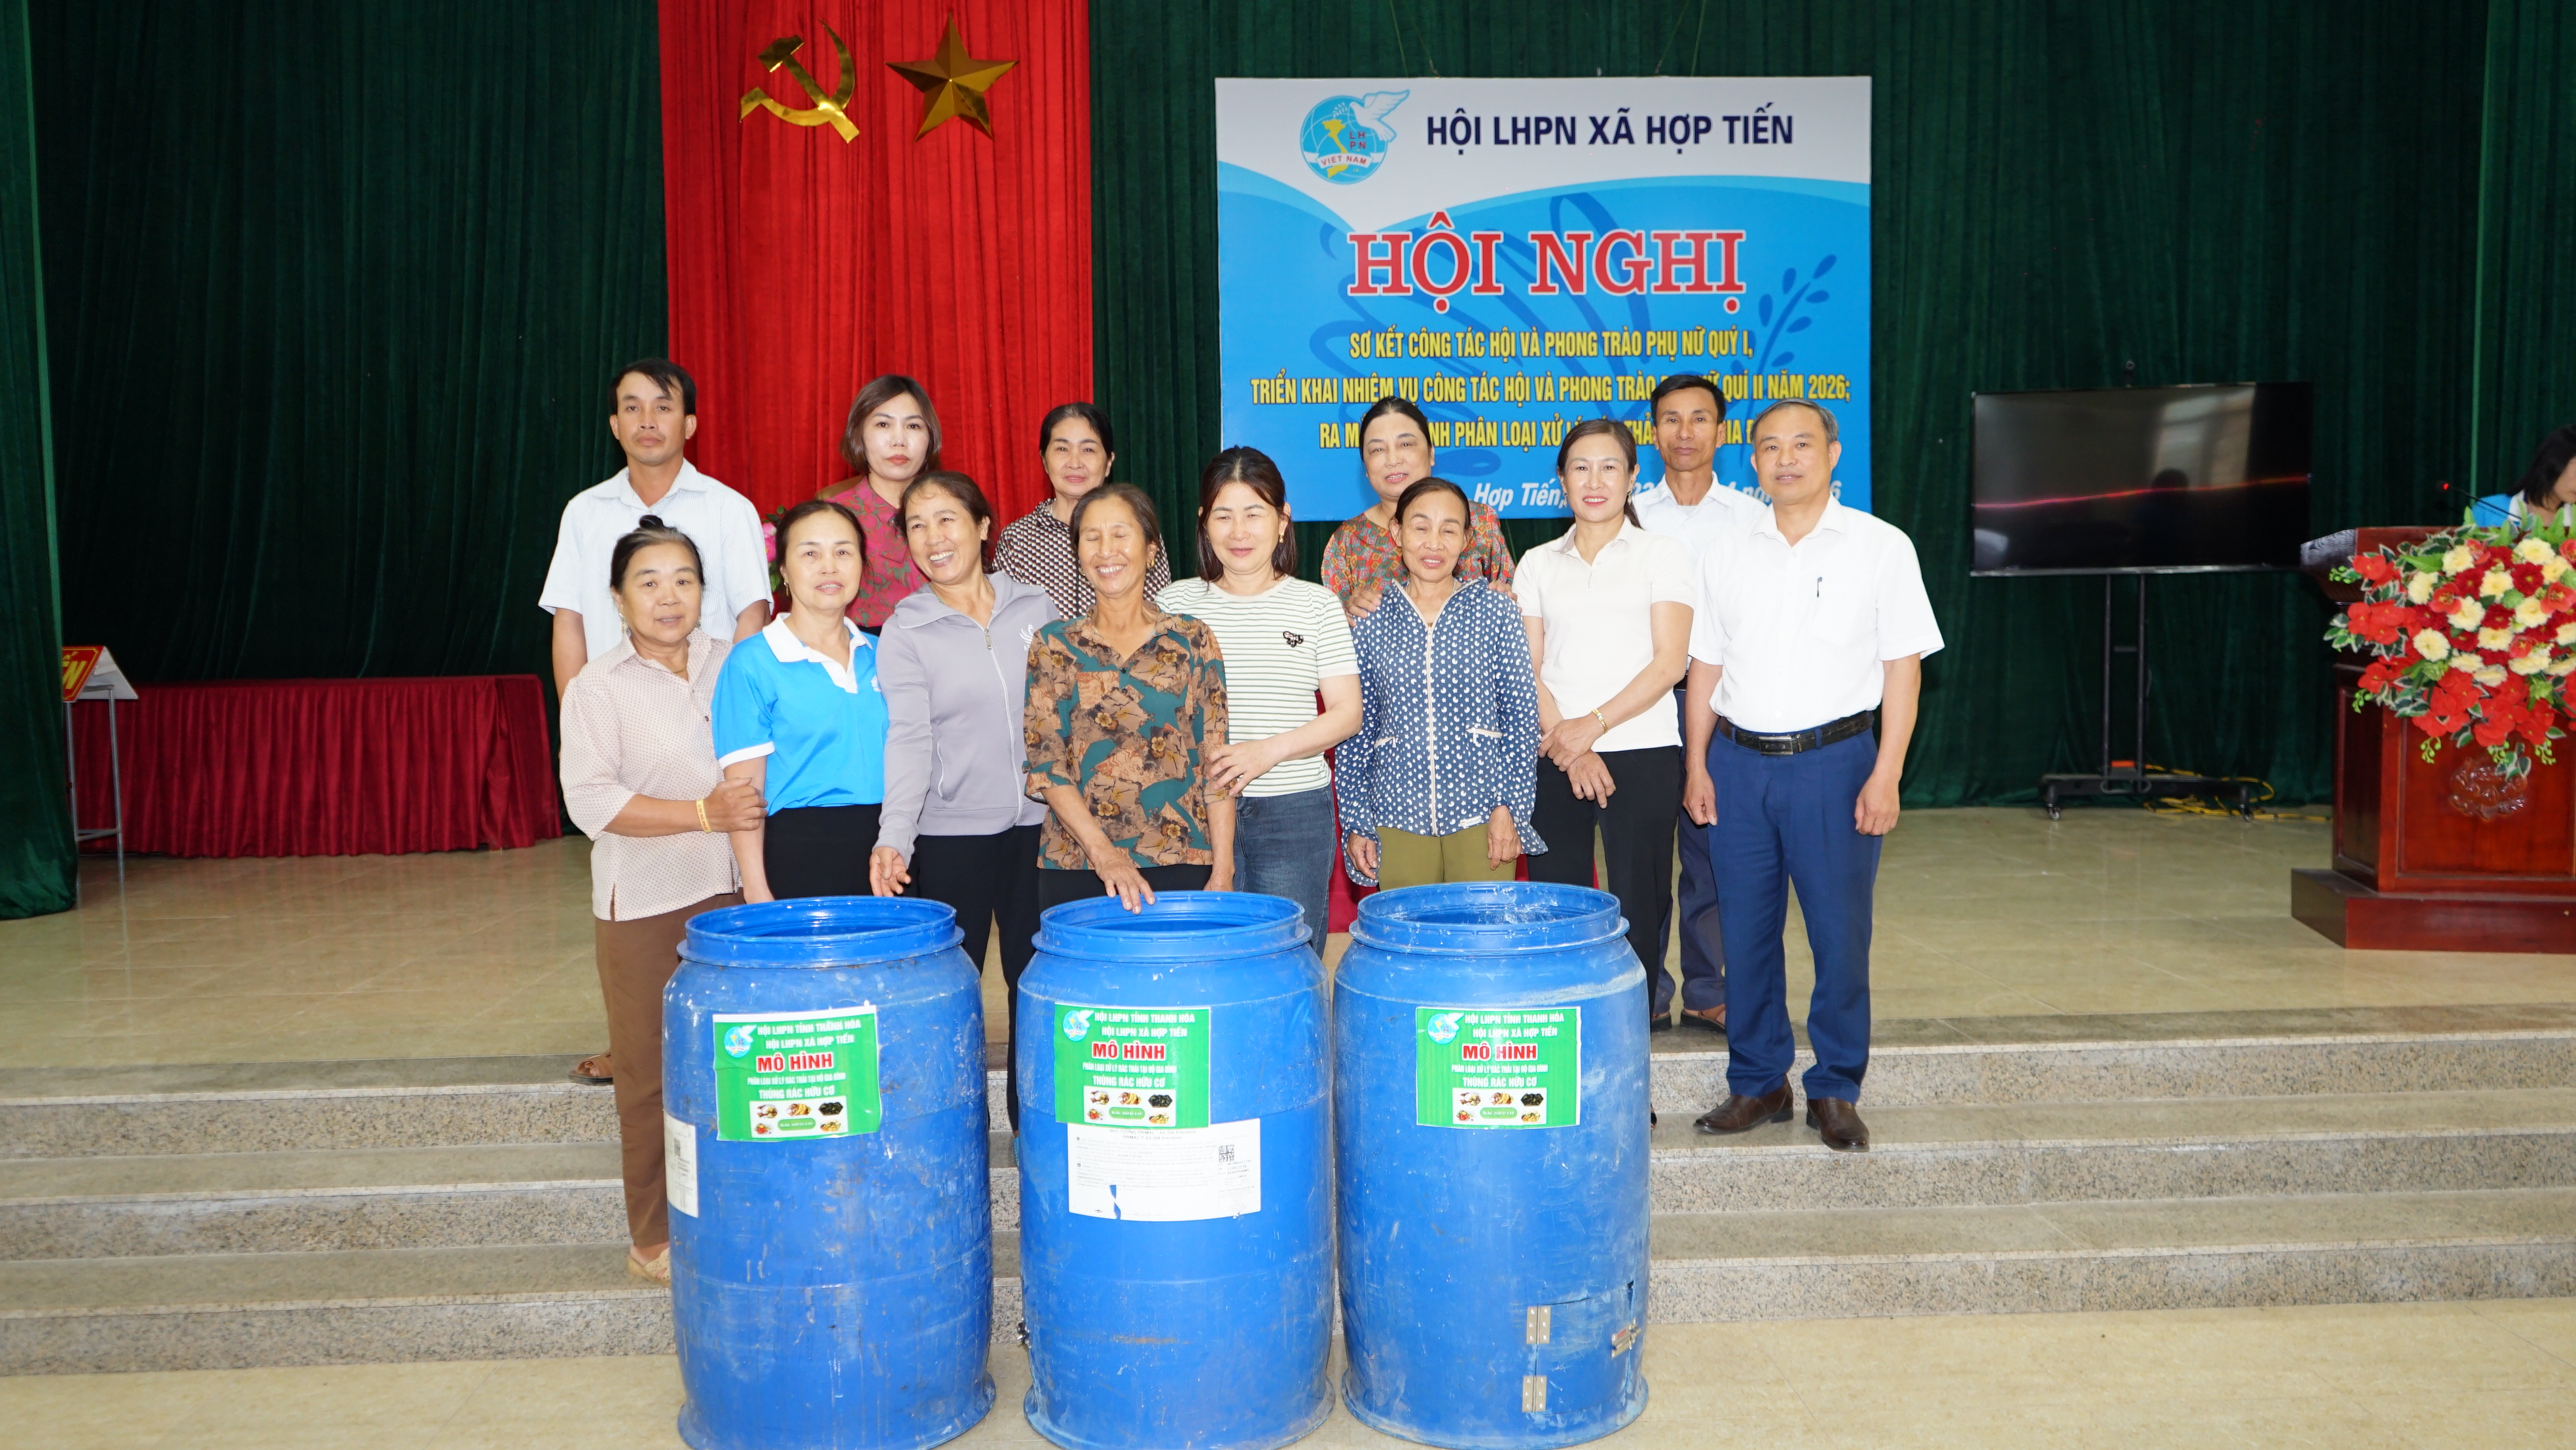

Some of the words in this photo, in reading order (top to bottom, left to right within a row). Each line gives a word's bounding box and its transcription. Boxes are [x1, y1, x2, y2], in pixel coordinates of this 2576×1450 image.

[1427, 108, 1482, 155] HỘI
[1494, 116, 1576, 145] LHPN
[1588, 107, 1635, 145] XÃ
[1647, 114, 1712, 154] HỢP
[1722, 102, 1793, 145] TIẾN
[1346, 155, 1367, 165] NAM
[1348, 211, 1503, 313] HỘI
[1530, 231, 1745, 313] NGHỊ
[1350, 330, 1371, 359] SƠ
[1376, 325, 1404, 358] KẾT
[1408, 327, 1452, 358] CÔNG
[1456, 327, 1486, 358] TÁC
[1490, 327, 1516, 362] HỘI
[1520, 327, 1541, 357] VÀ
[1545, 331, 1598, 357] PHONG
[1601, 326, 1642, 357] TRÀO
[1646, 330, 1677, 361] PHỤ
[1681, 325, 1706, 356] NỮ
[1708, 325, 1738, 359] QUÝ
[1742, 330, 1753, 358] I,
[1251, 368, 1297, 404] TRIỂN
[1301, 378, 1338, 404] KHAI
[1423, 372, 1466, 403] CÔNG
[1470, 371, 1499, 402] TÁC
[1504, 372, 1531, 408] HỘI
[1534, 371, 1555, 402] VÀ
[1559, 376, 1612, 402] PHONG
[1616, 370, 1656, 401] TRÀO
[1723, 370, 1748, 403] QUÍ
[1753, 375, 1764, 399] II
[1768, 370, 1804, 399] NĂM
[1808, 374, 1851, 402] 2026;
[1320, 423, 1341, 448] RA
[1427, 421, 1450, 447] NH
[1454, 416, 1497, 447] PHÂN
[1501, 420, 1537, 452] LOẠI
[1540, 412, 1564, 447] XỬ
[1723, 419, 1743, 444] IA
[1474, 483, 1513, 512] Hợp
[1094, 1012, 1107, 1023] HỘI
[1109, 1013, 1128, 1023] LHPN
[1151, 1014, 1177, 1023] THANH
[1179, 1012, 1195, 1023] HÓA
[1465, 1014, 1478, 1025] HỘI
[1480, 1015, 1501, 1024] LHPN
[1523, 1014, 1547, 1023] THANH
[1549, 1012, 1564, 1023] HÓA
[757, 1025, 770, 1036] HỘI
[772, 1025, 793, 1035] LHPN
[844, 1019, 861, 1029] HÓA
[1101, 1026, 1114, 1038] HỘI
[1116, 1027, 1136, 1037] LHPN
[1151, 1027, 1168, 1039] HỢP
[1170, 1026, 1187, 1037] TIẾN
[1473, 1027, 1486, 1039] HỘI
[1488, 1028, 1509, 1038] LHPN
[1524, 1027, 1539, 1038] HỢP
[1541, 1025, 1558, 1036] TIẾN
[766, 1039, 779, 1051] HỘI
[781, 1038, 802, 1048] LHPN
[817, 1036, 834, 1048] HỢP
[836, 1033, 854, 1044] TIẾN
[1093, 1041, 1118, 1058] MÔ
[1123, 1042, 1164, 1059] HÌNH
[1463, 1043, 1490, 1059] MÔ
[1496, 1043, 1537, 1059] HÌNH
[757, 1054, 783, 1071] MÔ
[790, 1052, 832, 1070] HÌNH
[1118, 1075, 1134, 1087] RÁC
[1154, 1078, 1166, 1088] CƠ
[1490, 1076, 1507, 1087] RÁC
[1526, 1076, 1537, 1087] CƠ
[786, 1088, 803, 1099] RÁC
[823, 1086, 834, 1096] CƠ
